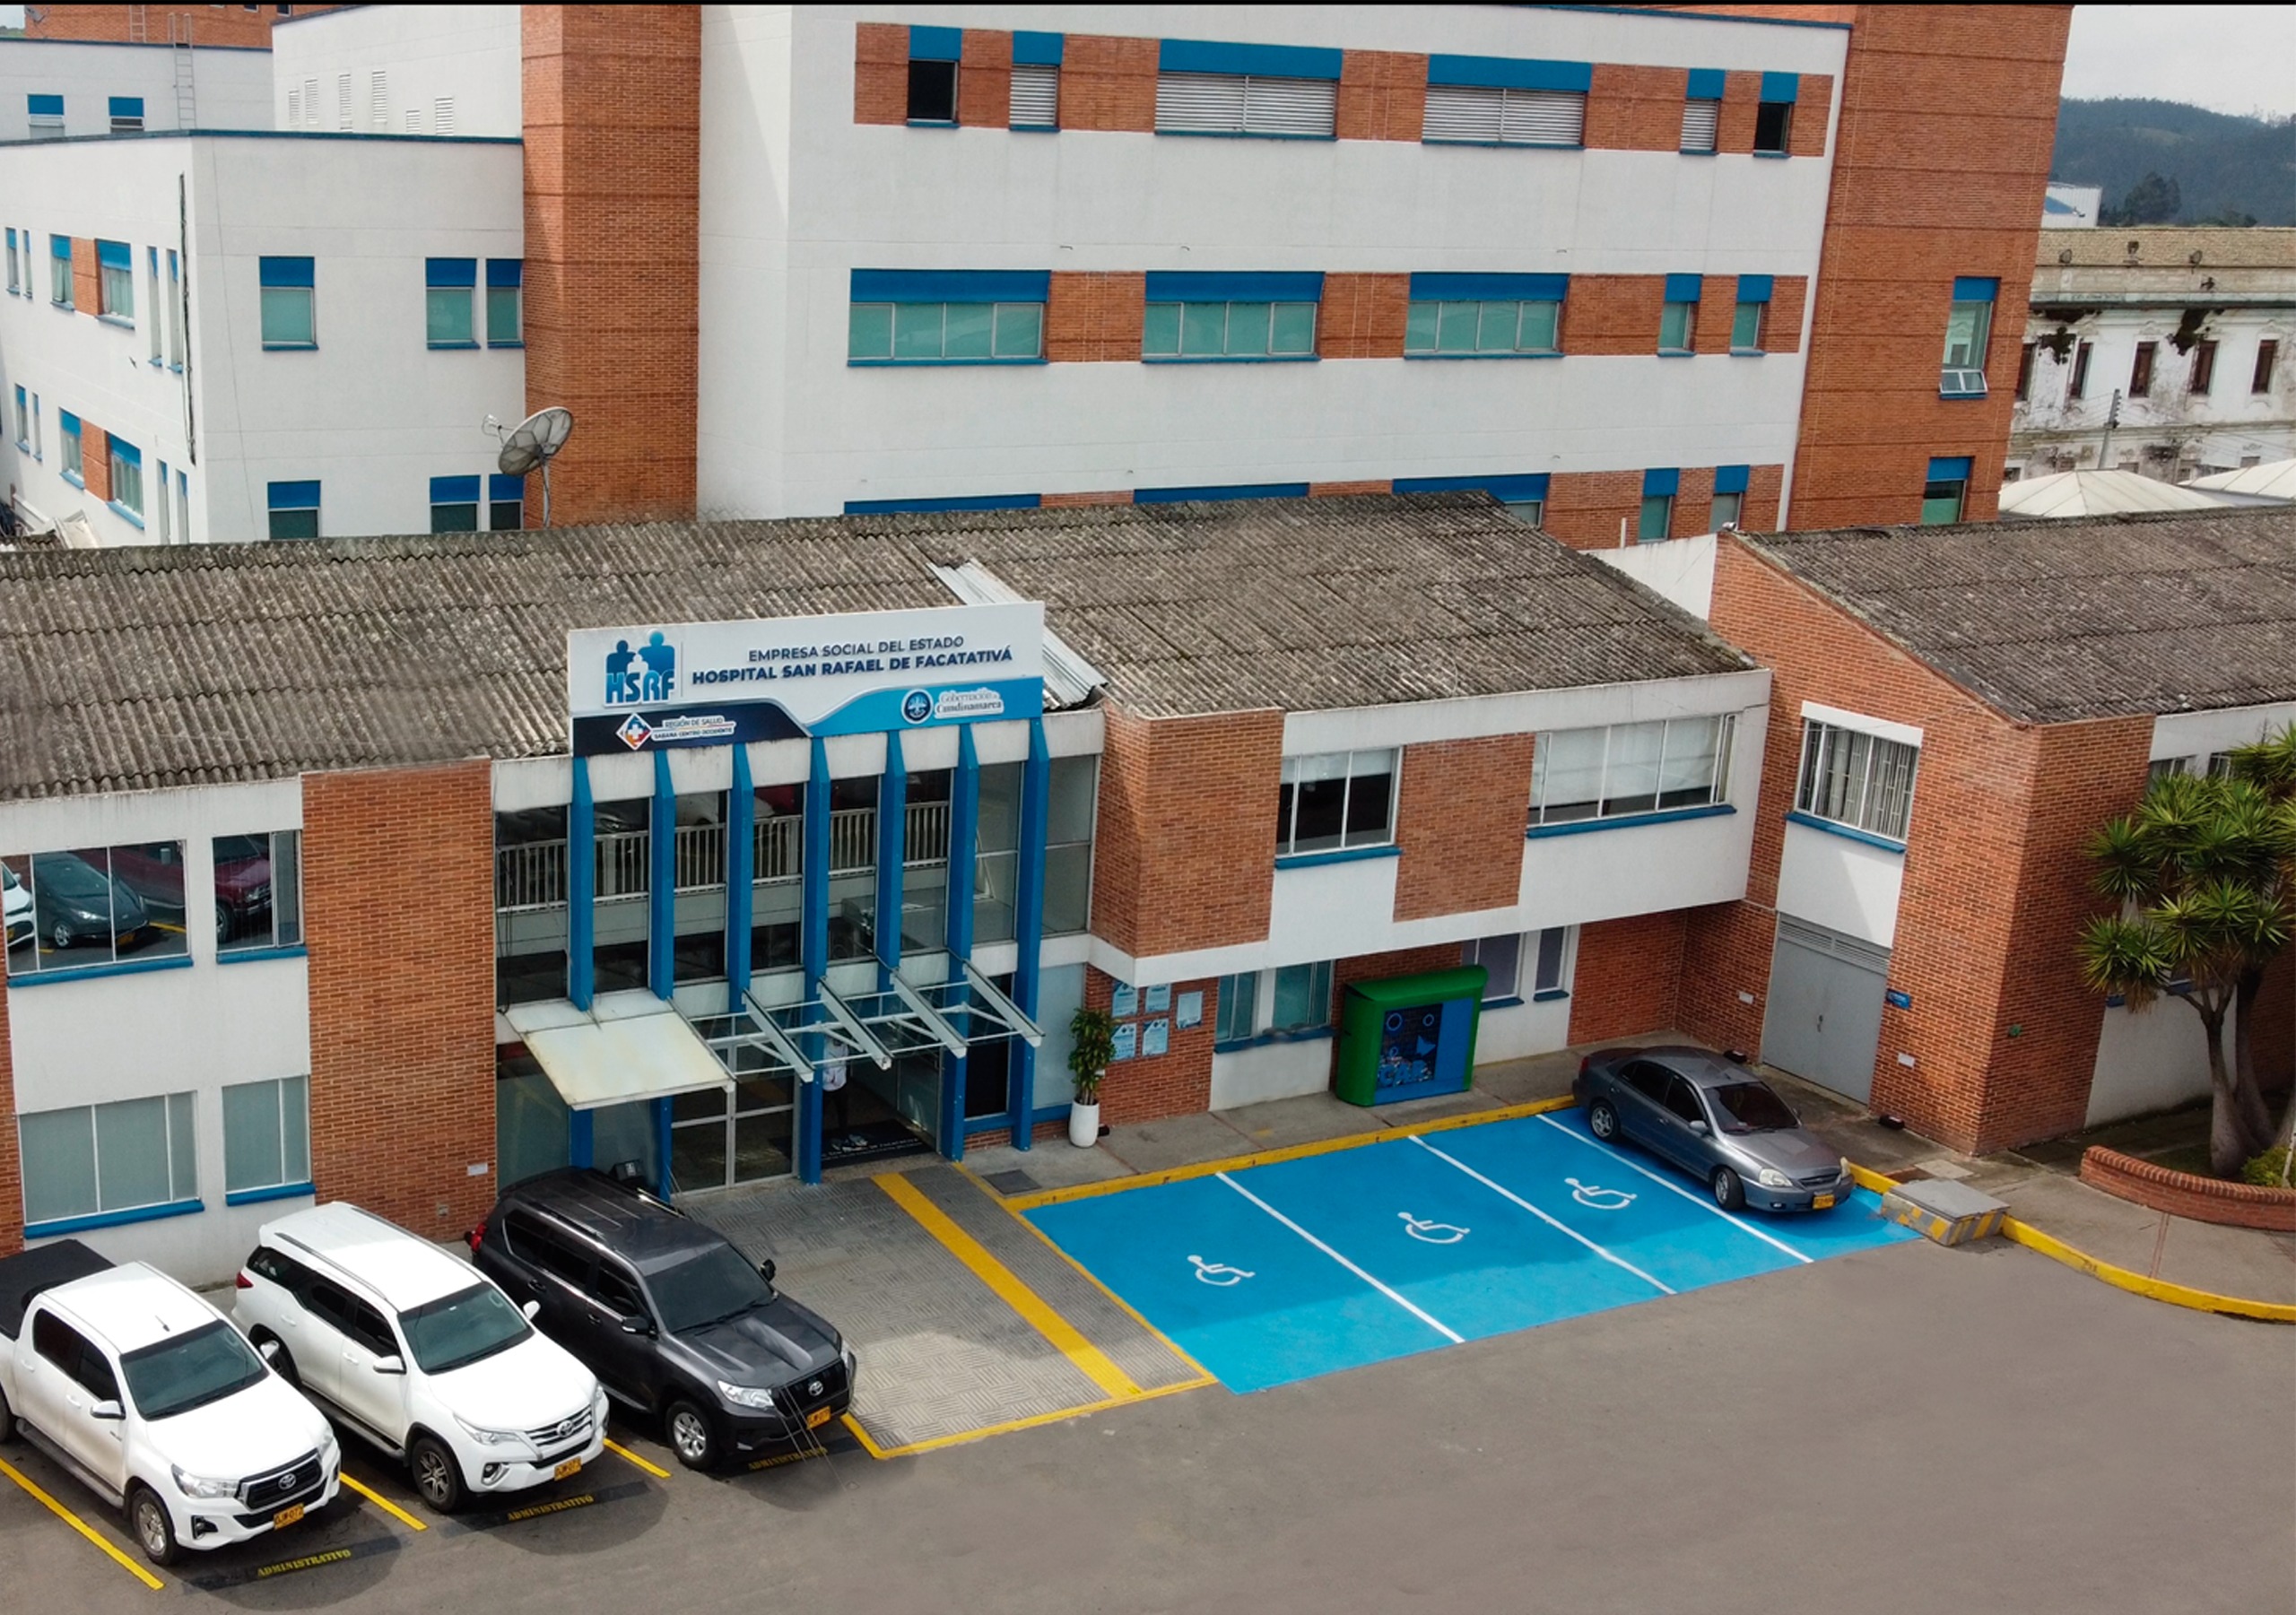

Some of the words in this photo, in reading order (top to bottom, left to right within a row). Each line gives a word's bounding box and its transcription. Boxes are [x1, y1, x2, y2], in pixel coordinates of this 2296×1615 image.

[748, 646, 818, 662] EMPRESA
[822, 642, 874, 657] SOCIAL
[878, 639, 905, 653] DEL
[909, 636, 964, 651] ESTADO
[691, 666, 778, 685] HOSPITAL
[782, 664, 816, 679] SAN
[822, 659, 884, 675] RAFAEL
[889, 656, 910, 671] DE
[916, 645, 1013, 668] FACATATIVÁ
[605, 669, 675, 704] HSRF
[701, 716, 724, 725] SALUD
[507, 1494, 594, 1521] ADMINISTRATIVO
[257, 1549, 352, 1576] ADMINISTRATIVO
